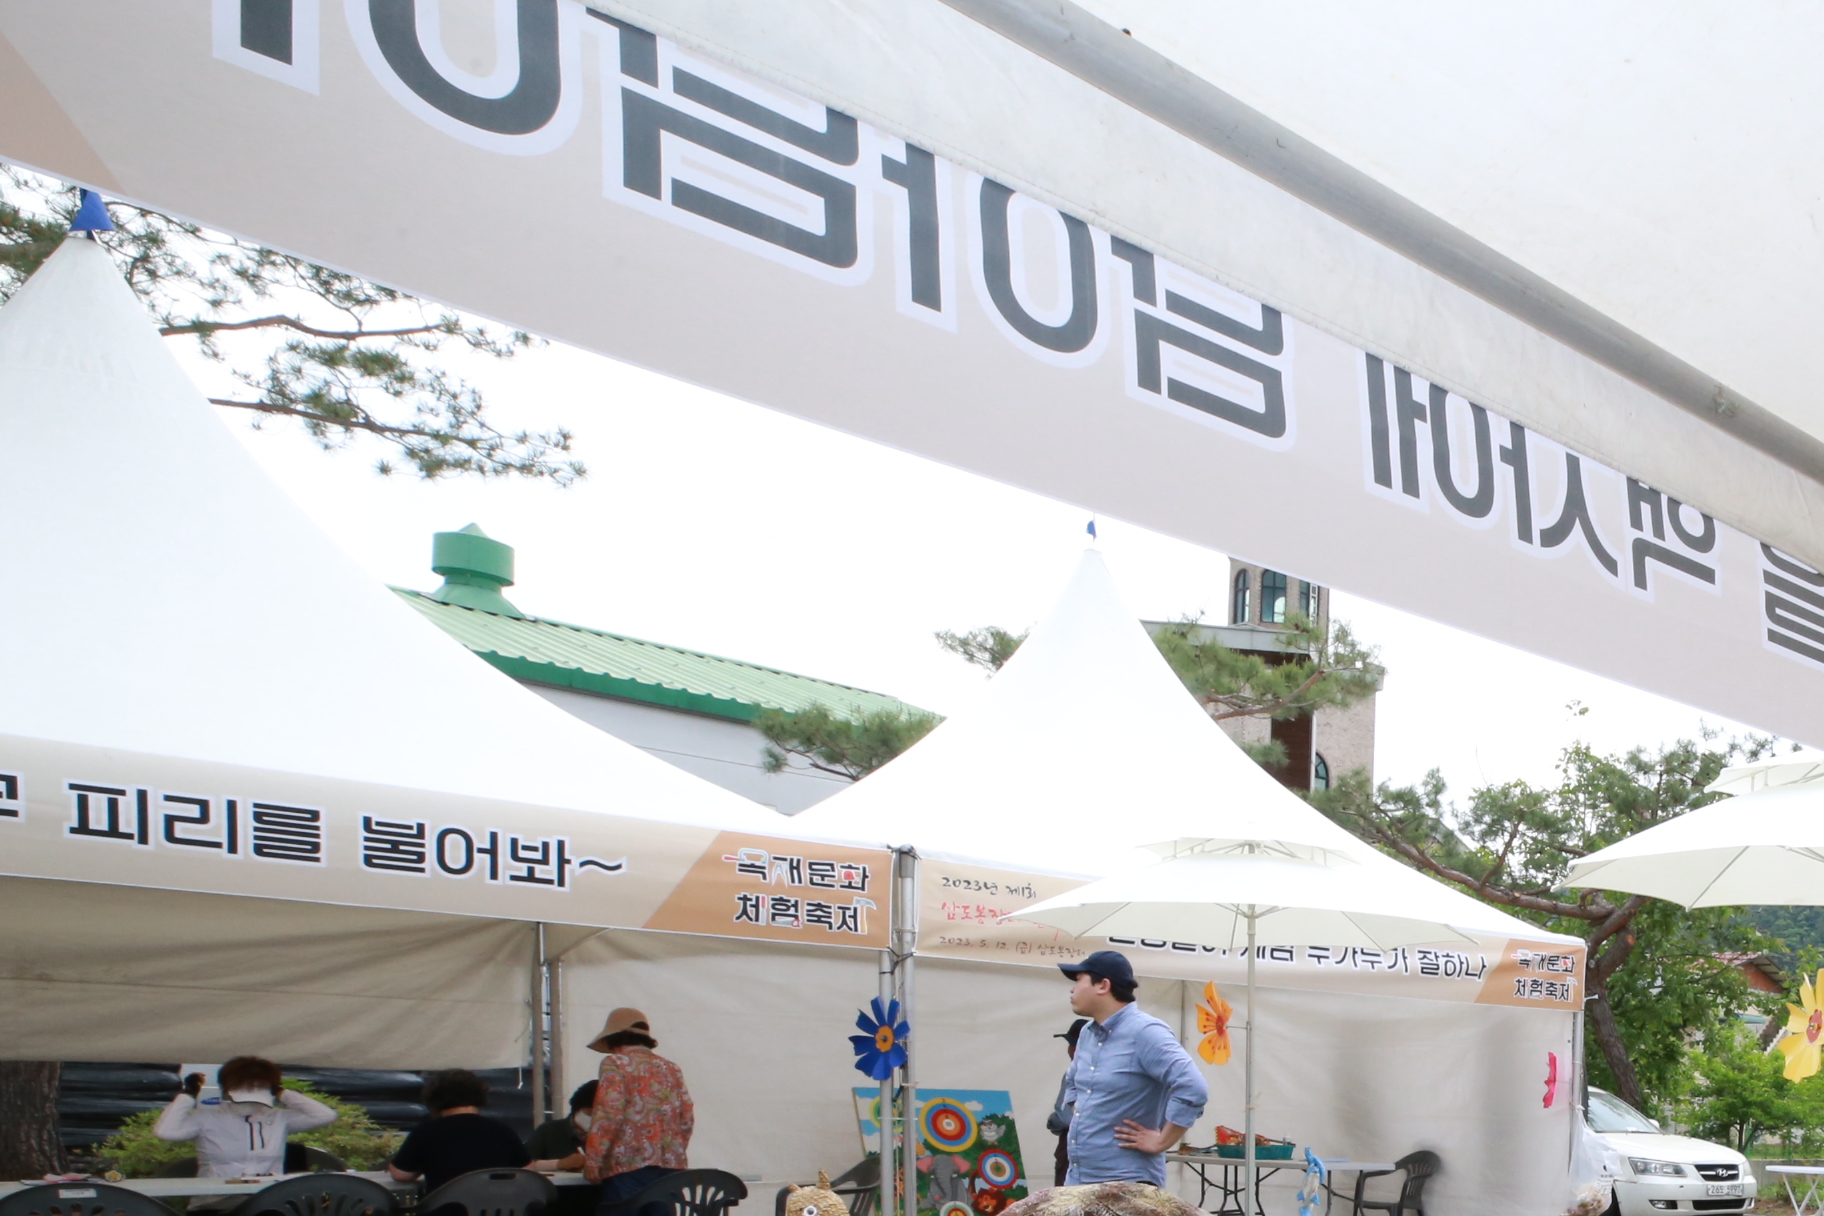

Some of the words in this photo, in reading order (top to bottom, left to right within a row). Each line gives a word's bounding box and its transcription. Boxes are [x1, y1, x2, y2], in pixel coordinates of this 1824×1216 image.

[67, 782, 322, 863] 피리를
[941, 876, 999, 896] 2023년
[941, 901, 1015, 926] 삼도봉장
[1417, 949, 1487, 980] 잘하나
